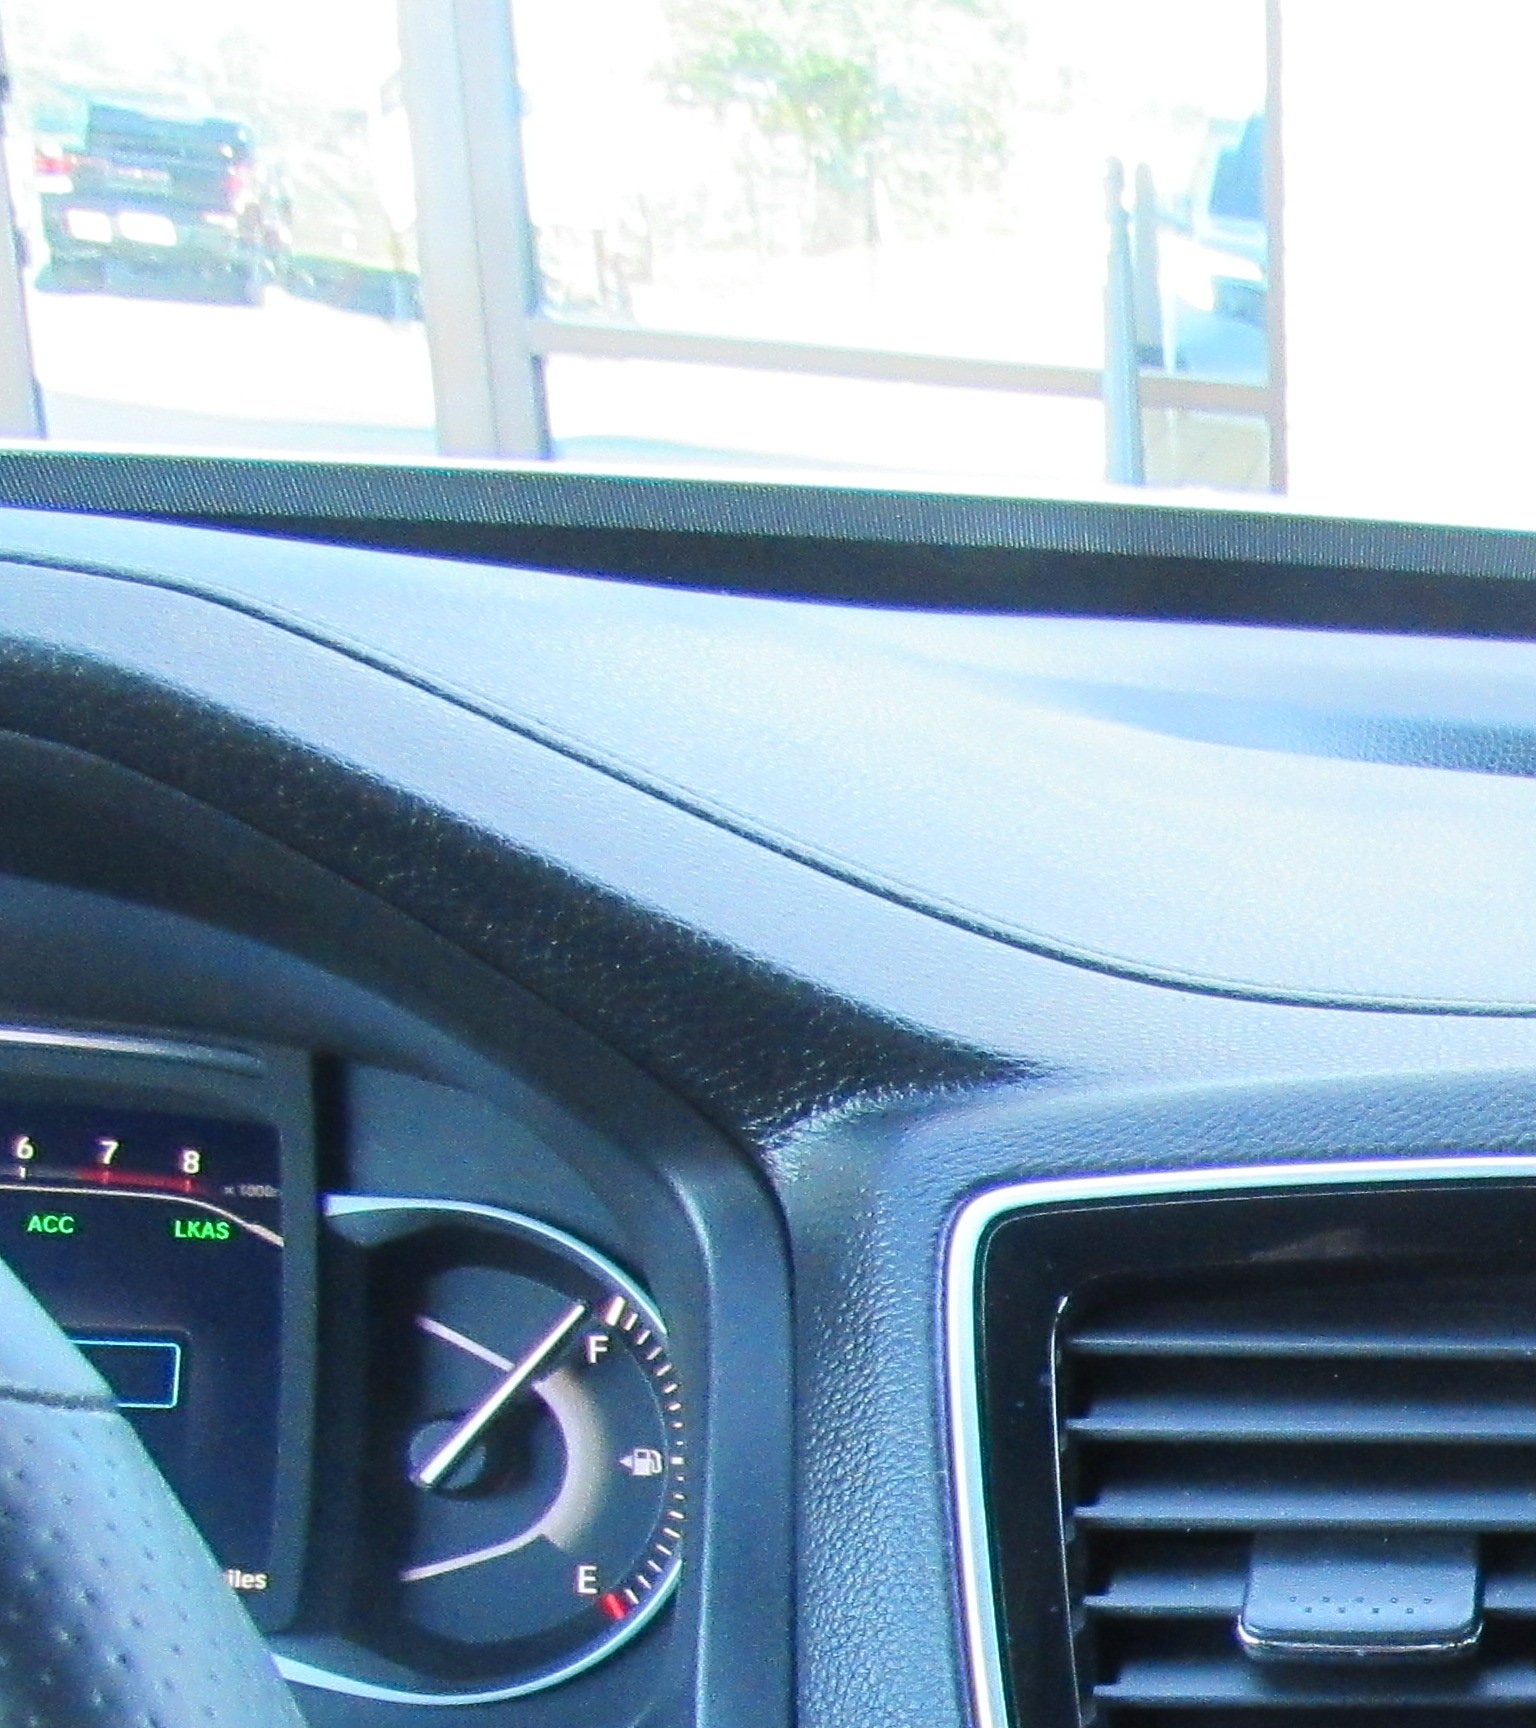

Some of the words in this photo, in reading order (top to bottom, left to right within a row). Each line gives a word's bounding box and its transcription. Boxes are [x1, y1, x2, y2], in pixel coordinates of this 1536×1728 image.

[16, 1136, 34, 1160] 6
[100, 1140, 118, 1164] 7
[181, 1150, 199, 1173] 8
[28, 1215, 74, 1233] ACC
[174, 1219, 230, 1240] LKAS
[587, 1334, 608, 1364] F
[227, 1569, 268, 1590] iles
[576, 1565, 598, 1595] E
